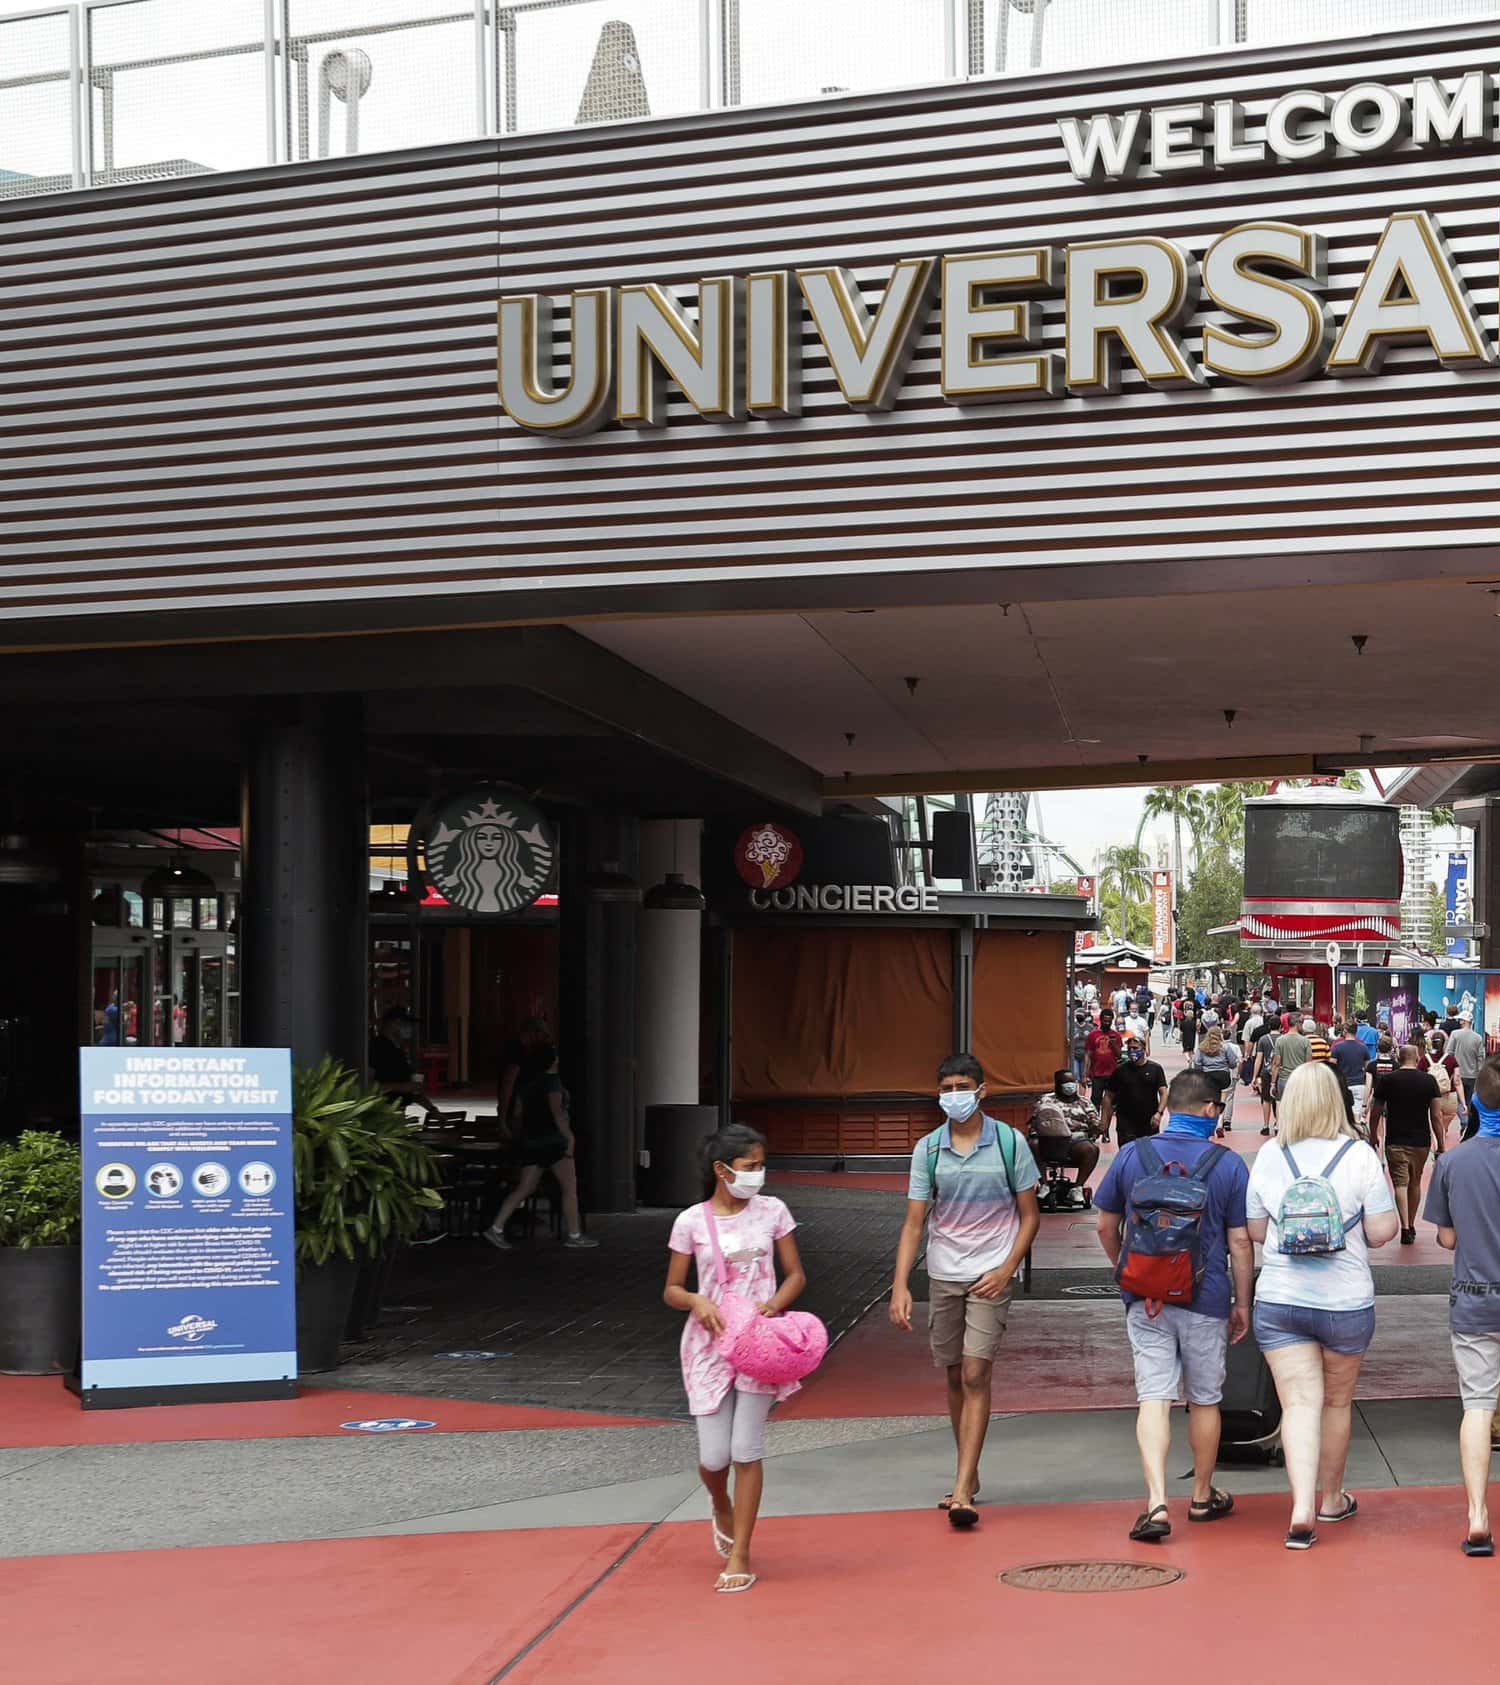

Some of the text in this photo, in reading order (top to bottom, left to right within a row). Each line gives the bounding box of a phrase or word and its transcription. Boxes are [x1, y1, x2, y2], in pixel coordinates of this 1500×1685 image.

[751, 884, 939, 911] CONCIERGE
[1455, 878, 1467, 926] DANC
[1154, 889, 1164, 955] SANDWICHES
[1445, 910, 1455, 946] CLB
[126, 1057, 247, 1072] IMPORTANT
[113, 1073, 260, 1088] INFORMATION
[93, 1089, 279, 1105] FOR TODAY'S VISIT
[167, 1319, 219, 1335] UNIVERSAL
